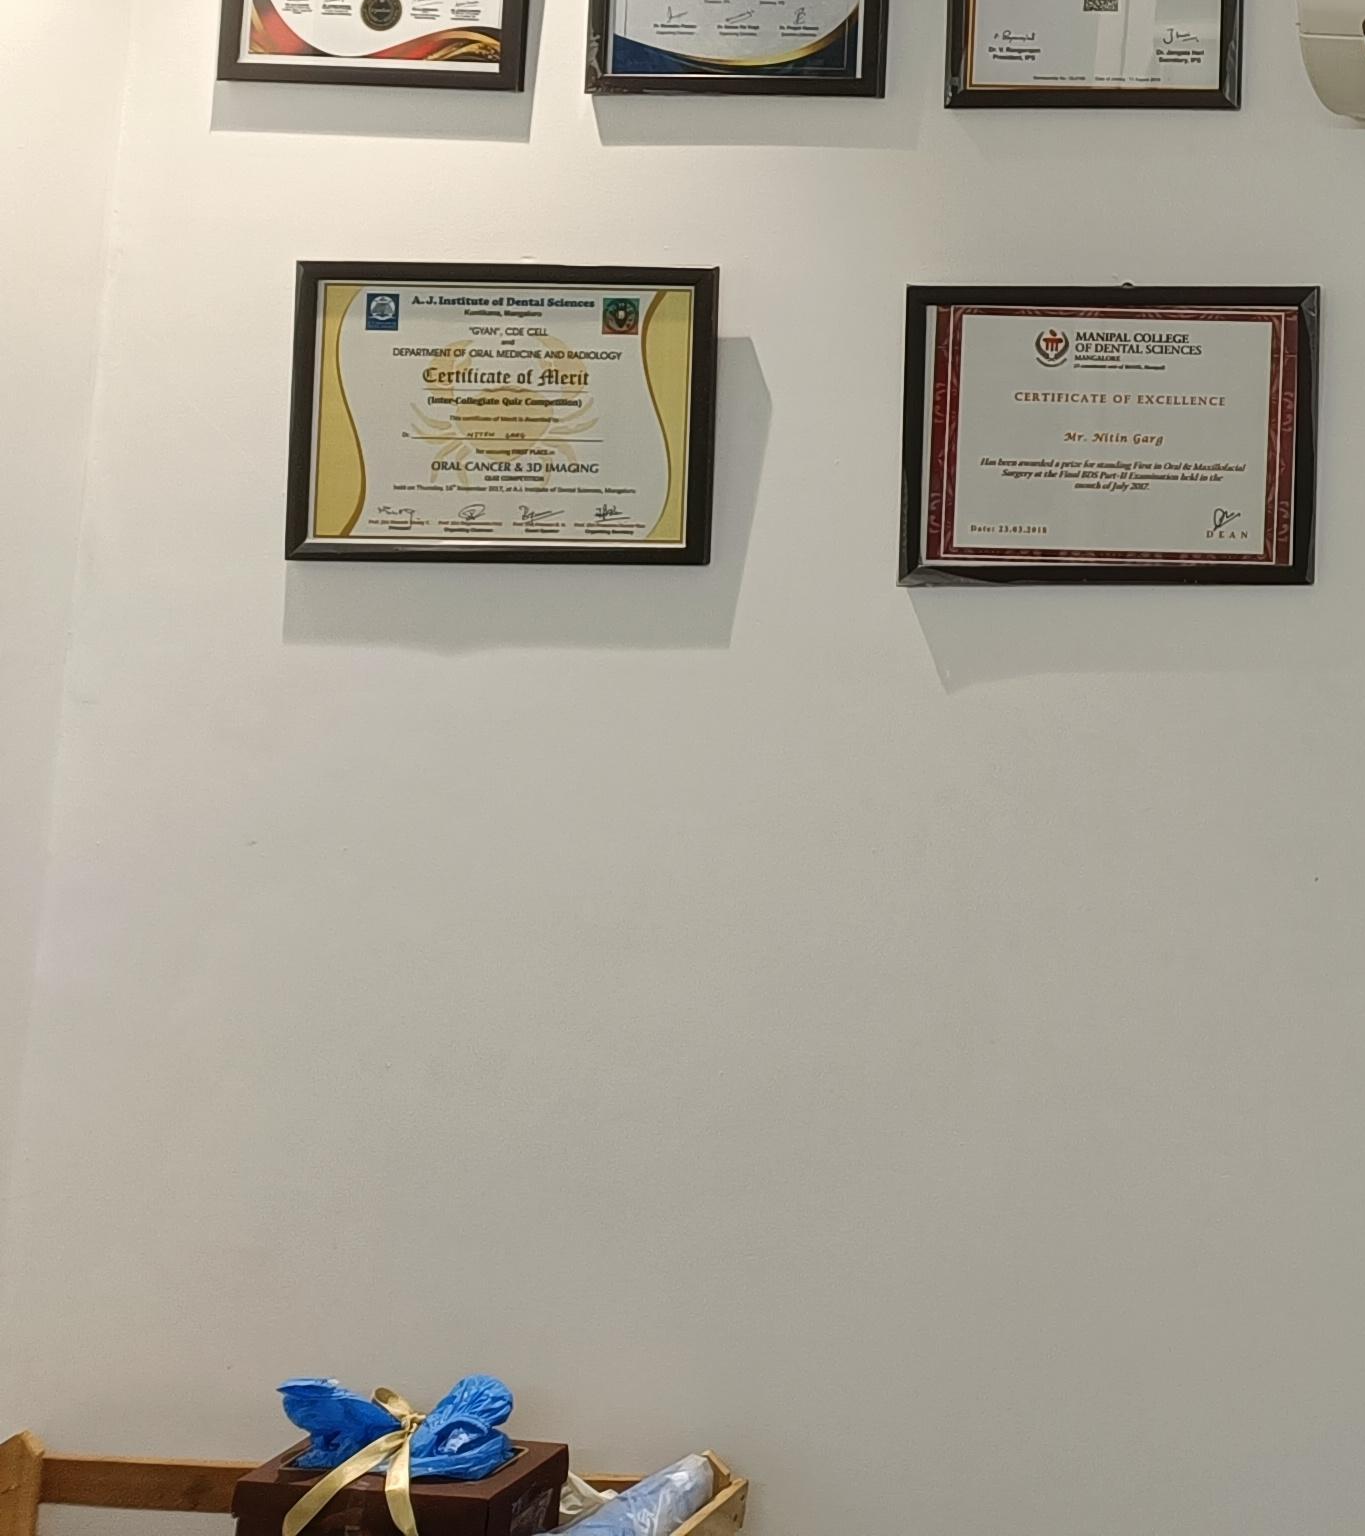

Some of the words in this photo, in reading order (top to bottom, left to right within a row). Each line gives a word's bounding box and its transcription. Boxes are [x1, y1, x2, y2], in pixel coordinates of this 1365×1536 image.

[439, 297, 490, 306] Institute
[492, 297, 504, 306] of
[506, 298, 545, 307] Dental
[547, 299, 595, 308] Sciences
[527, 328, 548, 336] CELL
[1076, 332, 1130, 342] MANIPAL
[1134, 333, 1189, 343] COLLEGE
[393, 347, 450, 357] DEPARTMENT
[454, 349, 467, 357] OF
[469, 349, 493, 358] ORAL
[496, 350, 541, 359] MEDICINE
[544, 351, 564, 359] AND
[567, 351, 623, 360] RADIOLOGY
[1075, 343, 1092, 353] OF
[1095, 344, 1143, 354] DENTAL
[1146, 345, 1202, 355] SCIENCES
[422, 368, 510, 385] Certificate
[517, 369, 532, 384] of
[537, 370, 589, 386] Merit
[1015, 392, 1107, 403] CERTIFICATE
[1113, 394, 1131, 404] OF
[1137, 396, 1225, 406] EXCELLENCE
[1064, 432, 1087, 442] Mr.
[1092, 433, 1128, 443] Nitin
[1134, 434, 1164, 446] Garg
[431, 461, 461, 471] ORAL
[464, 462, 511, 473] CANCER
[515, 463, 523, 472] &
[526, 463, 542, 473] 3D
[545, 463, 599, 474] IMAGING
